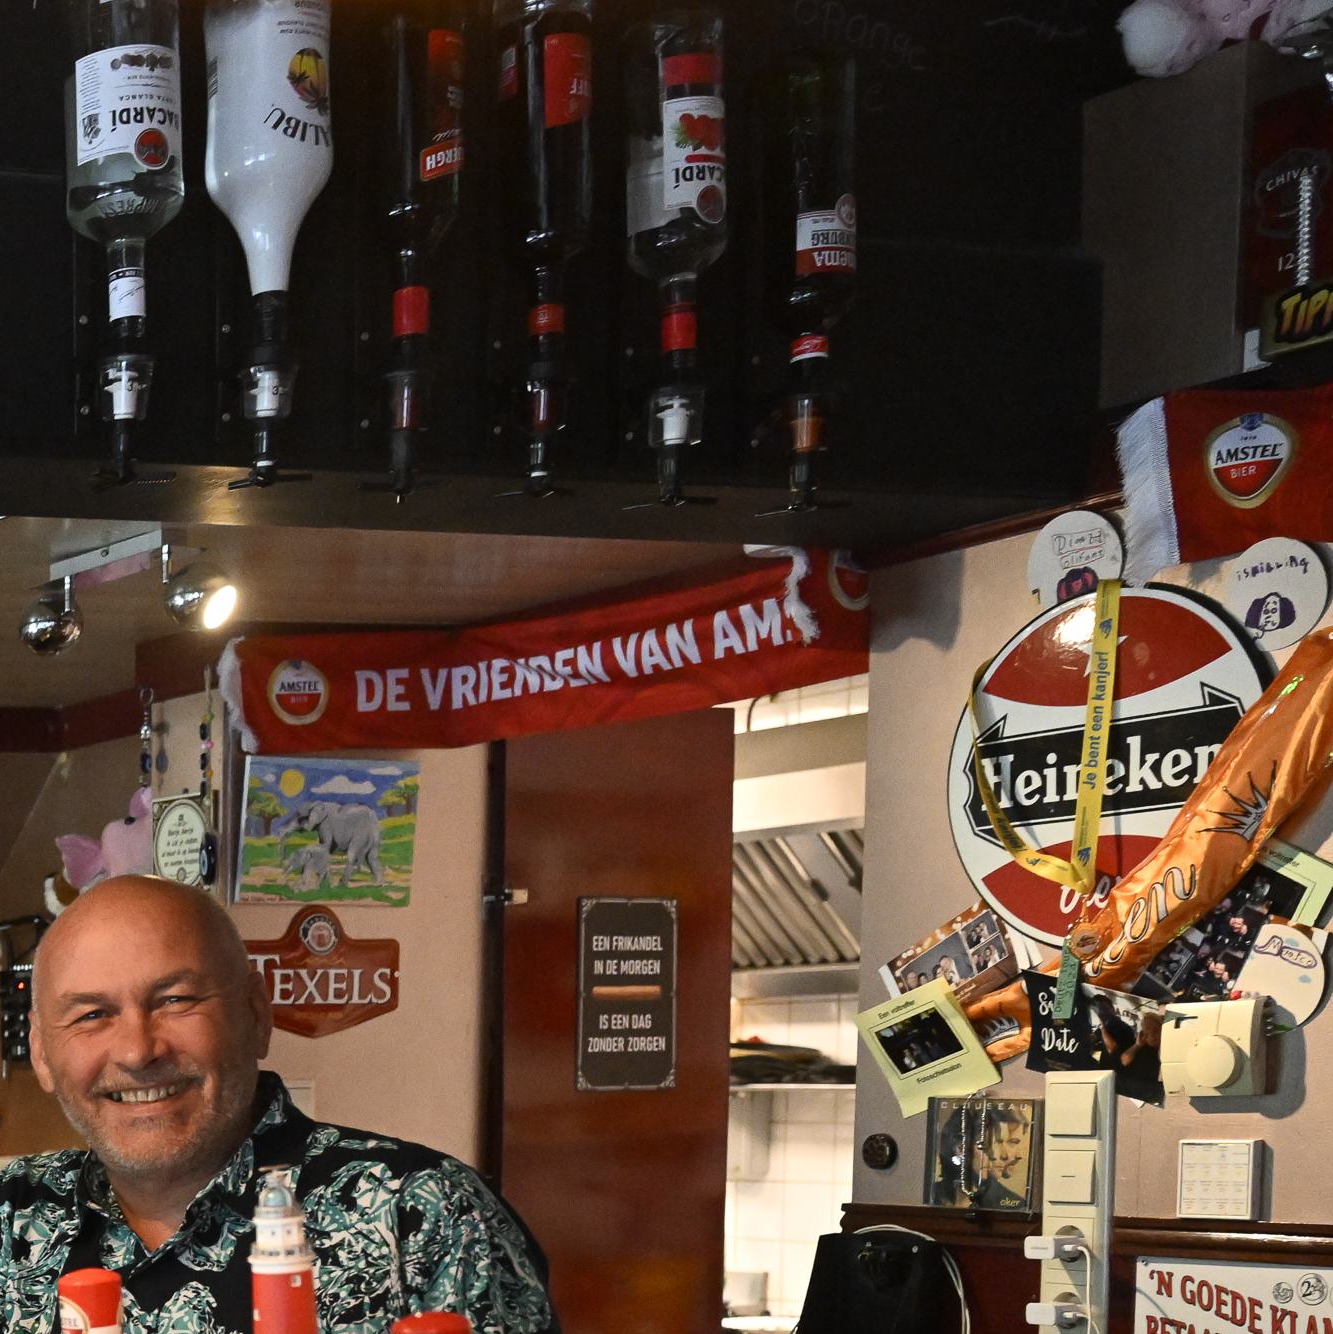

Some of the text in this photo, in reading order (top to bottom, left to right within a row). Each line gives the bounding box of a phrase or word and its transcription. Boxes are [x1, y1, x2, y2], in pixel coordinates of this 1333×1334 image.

[672, 165, 724, 190] CARDÍ
[1213, 443, 1283, 466] AMSTEL
[1229, 465, 1257, 479] BIER
[354, 598, 792, 713] DE VRIENDEN VAN AM
[279, 680, 320, 692] AMSTEL
[1092, 650, 1109, 705] kanjer!
[1090, 705, 1104, 732] een
[1084, 735, 1101, 769] bent
[1082, 772, 1096, 790] Je
[592, 935, 664, 952] EEN FRIKANDEL
[247, 953, 393, 1005] TEXELS
[594, 959, 662, 976] IN DE MORGEN
[599, 1013, 653, 1030] IS EEN DAG
[587, 1036, 667, 1053] ZONDER ZORGEN
[1040, 1025, 1080, 1054] Date
